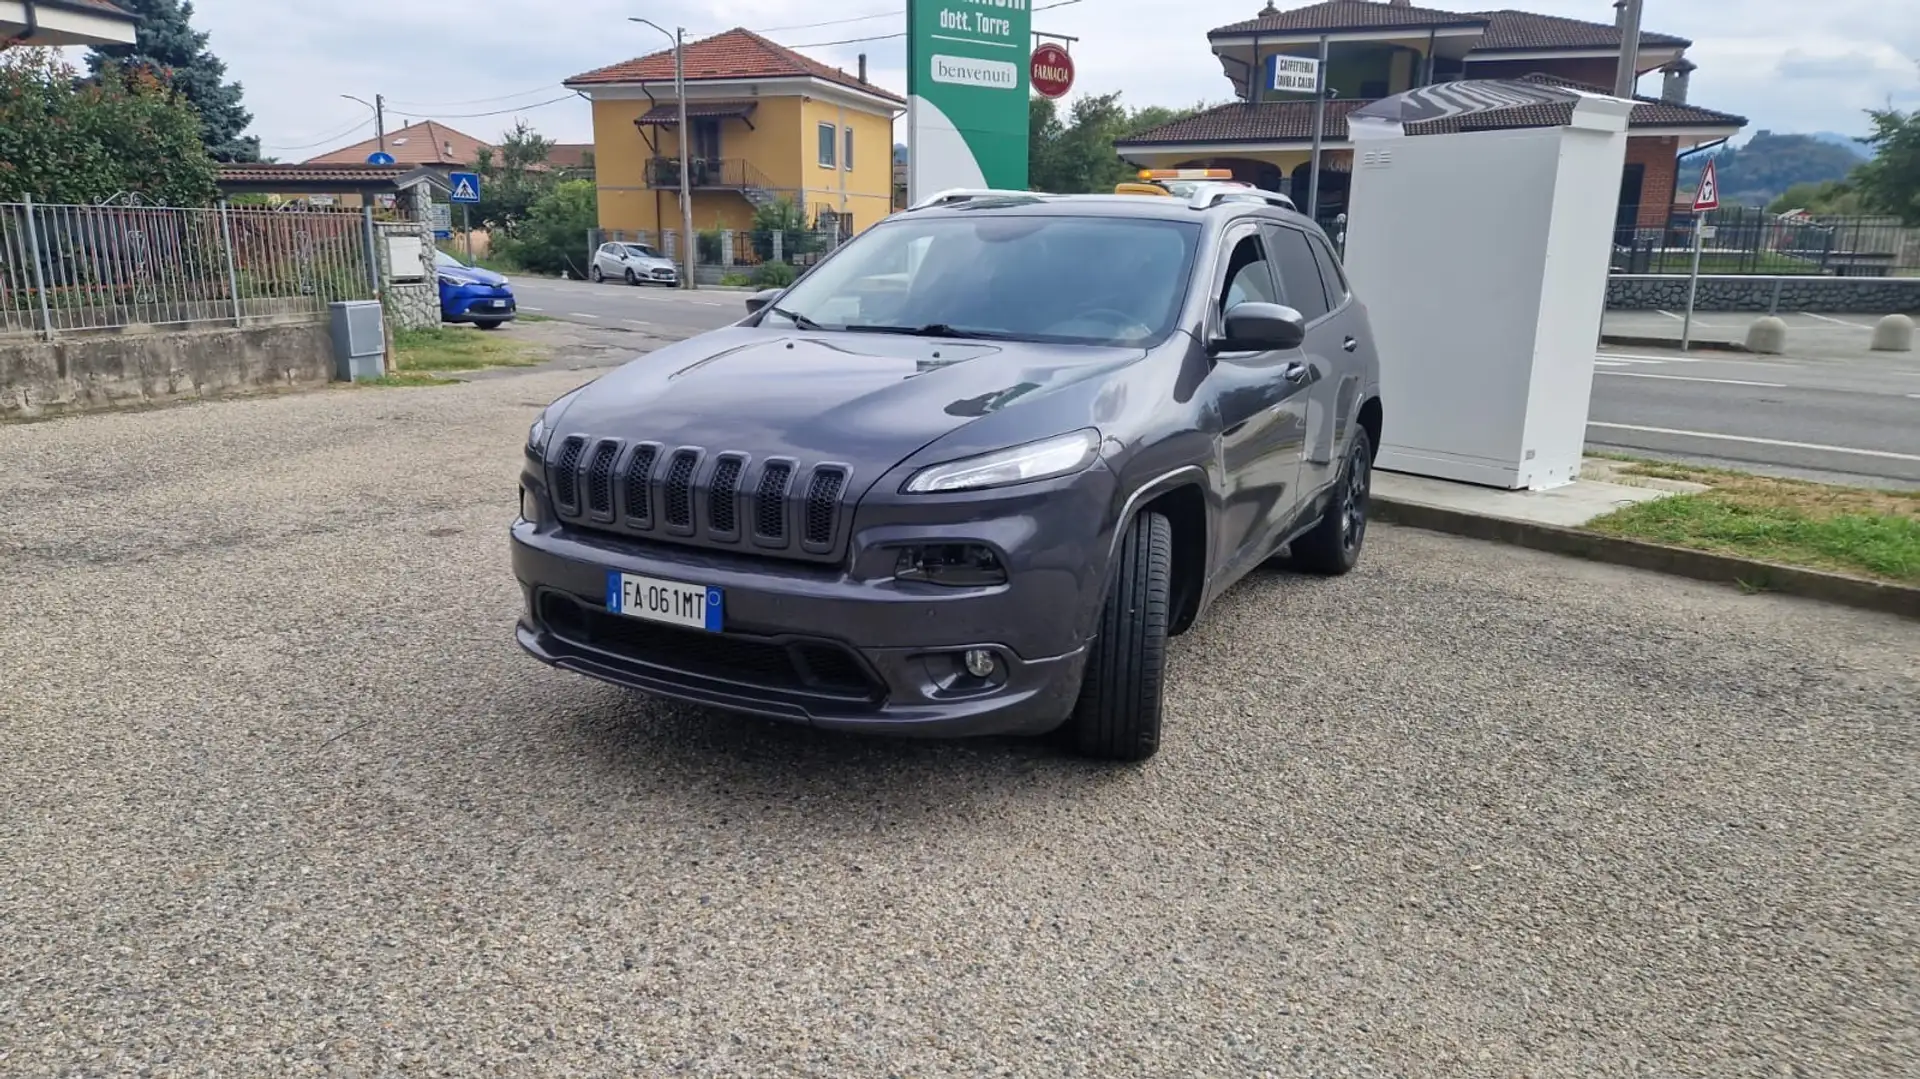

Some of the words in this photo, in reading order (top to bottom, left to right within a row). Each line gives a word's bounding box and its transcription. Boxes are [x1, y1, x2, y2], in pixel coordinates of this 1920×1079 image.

[940, 8, 972, 31] dott.
[975, 12, 1010, 36] Torre
[938, 60, 1011, 83] benvenuti
[1033, 63, 1069, 83] FARMACIA
